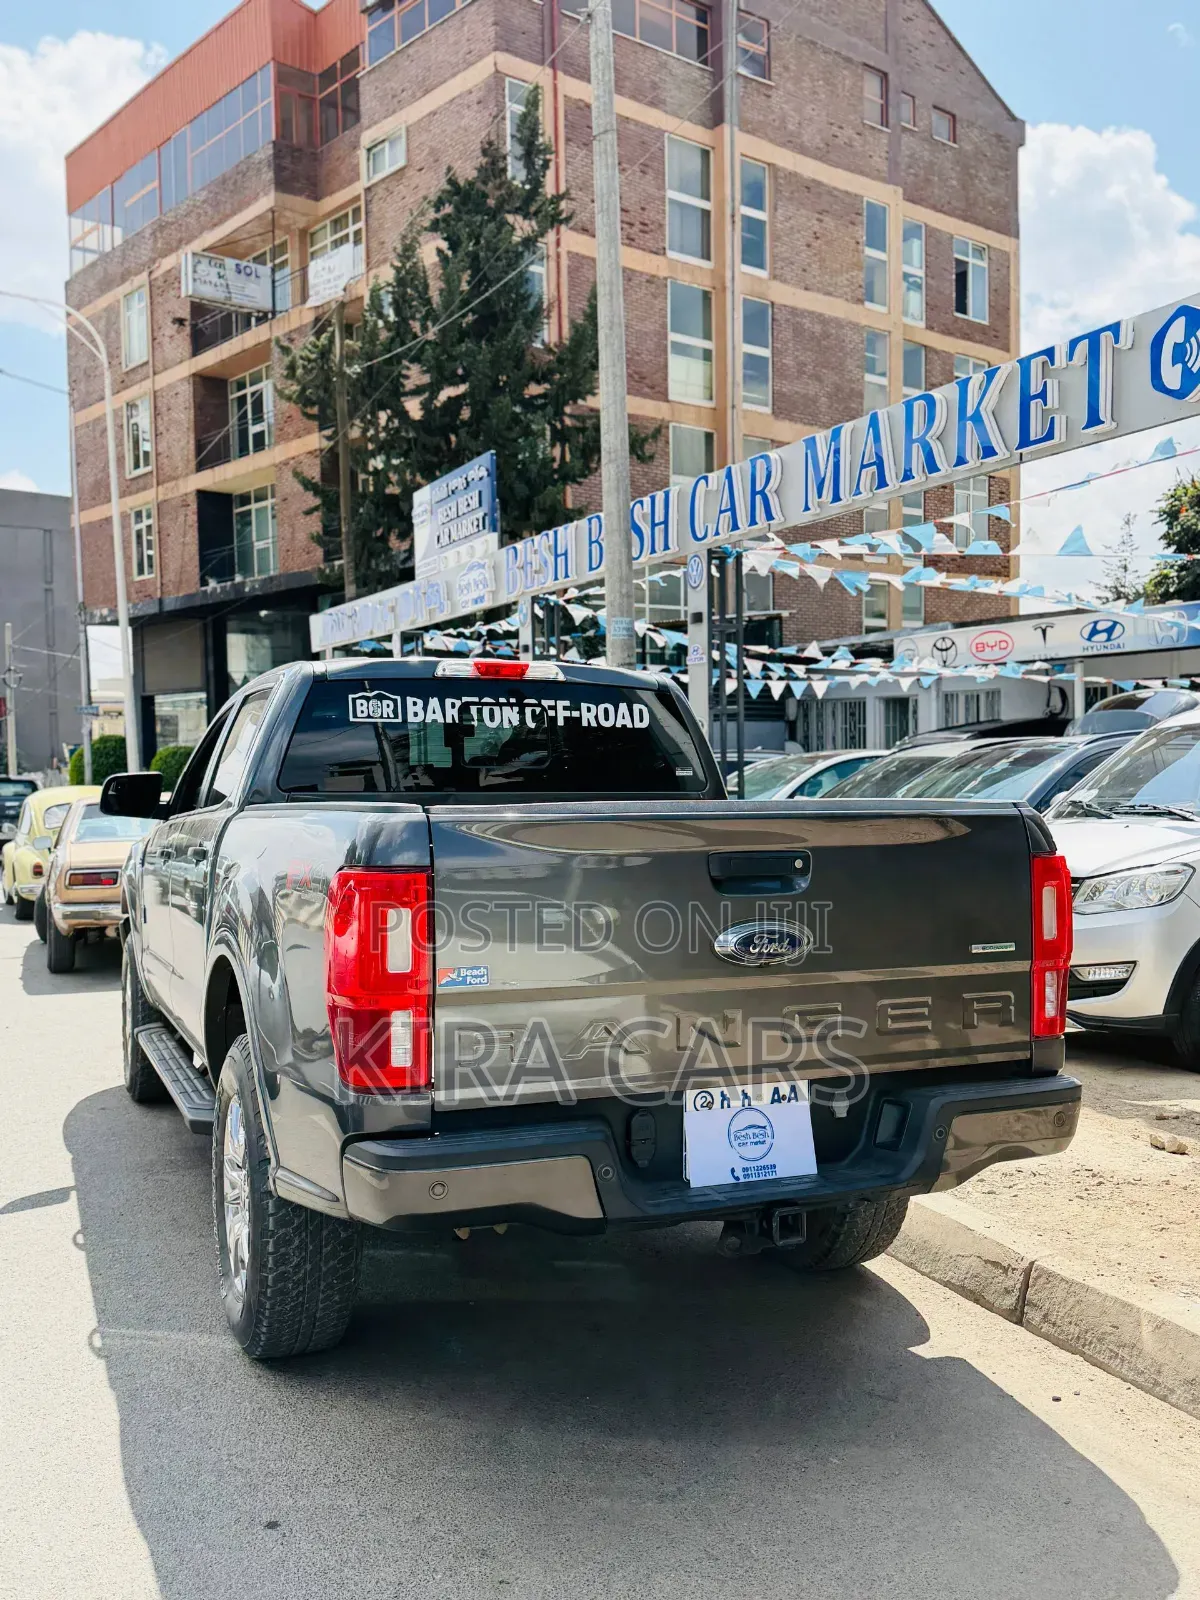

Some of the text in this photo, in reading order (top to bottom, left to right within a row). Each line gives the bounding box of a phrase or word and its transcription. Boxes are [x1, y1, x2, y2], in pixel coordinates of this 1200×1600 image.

[234, 262, 261, 280] SOL
[507, 319, 1134, 597] BESH BSH CAR MARKET
[458, 490, 481, 517] BESH
[450, 512, 485, 543] MARKET
[975, 639, 1008, 653] BYD
[1082, 643, 1125, 653] HYUNDAI
[750, 934, 790, 954] Ford
[460, 967, 487, 977] Beach
[466, 975, 488, 985] Ford
